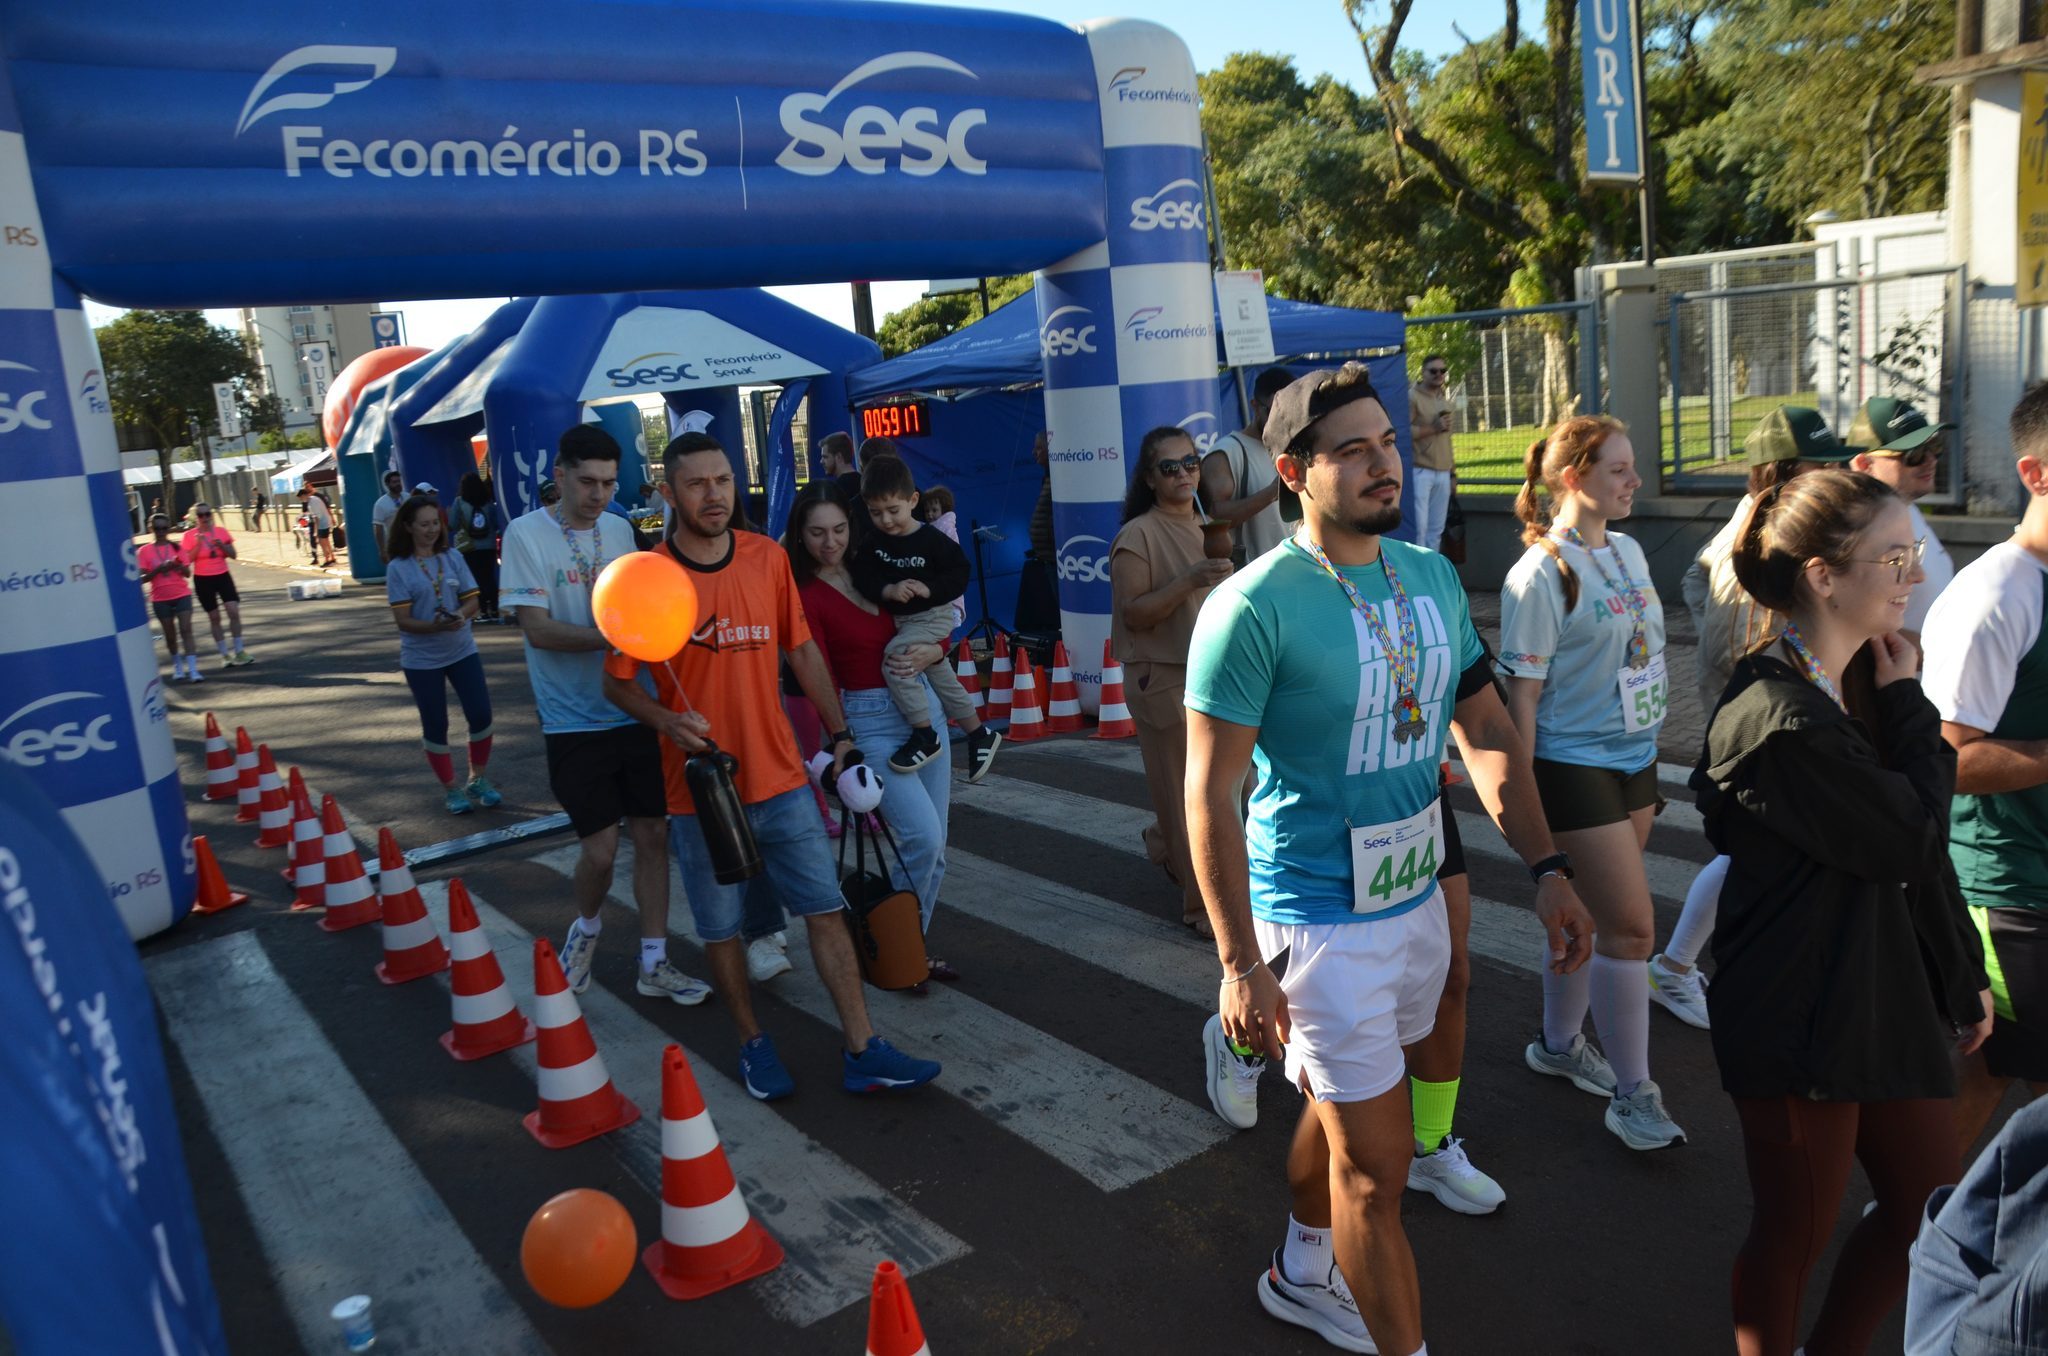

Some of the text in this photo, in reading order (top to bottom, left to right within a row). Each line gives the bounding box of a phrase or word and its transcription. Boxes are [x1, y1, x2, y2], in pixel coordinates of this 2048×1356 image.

[1592, 0, 1625, 169] URI
[774, 92, 988, 176] Sesc
[281, 124, 708, 178] Fecomércio RS
[4, 225, 40, 247] RS
[703, 352, 782, 367] Fecomércio
[606, 363, 700, 388] Sesc
[712, 366, 756, 378] Senac
[1098, 446, 1119, 461] RS
[69, 562, 99, 583] RS
[1363, 836, 1392, 850] Sesc
[135, 867, 163, 889] RS
[1368, 835, 1437, 901] 444
